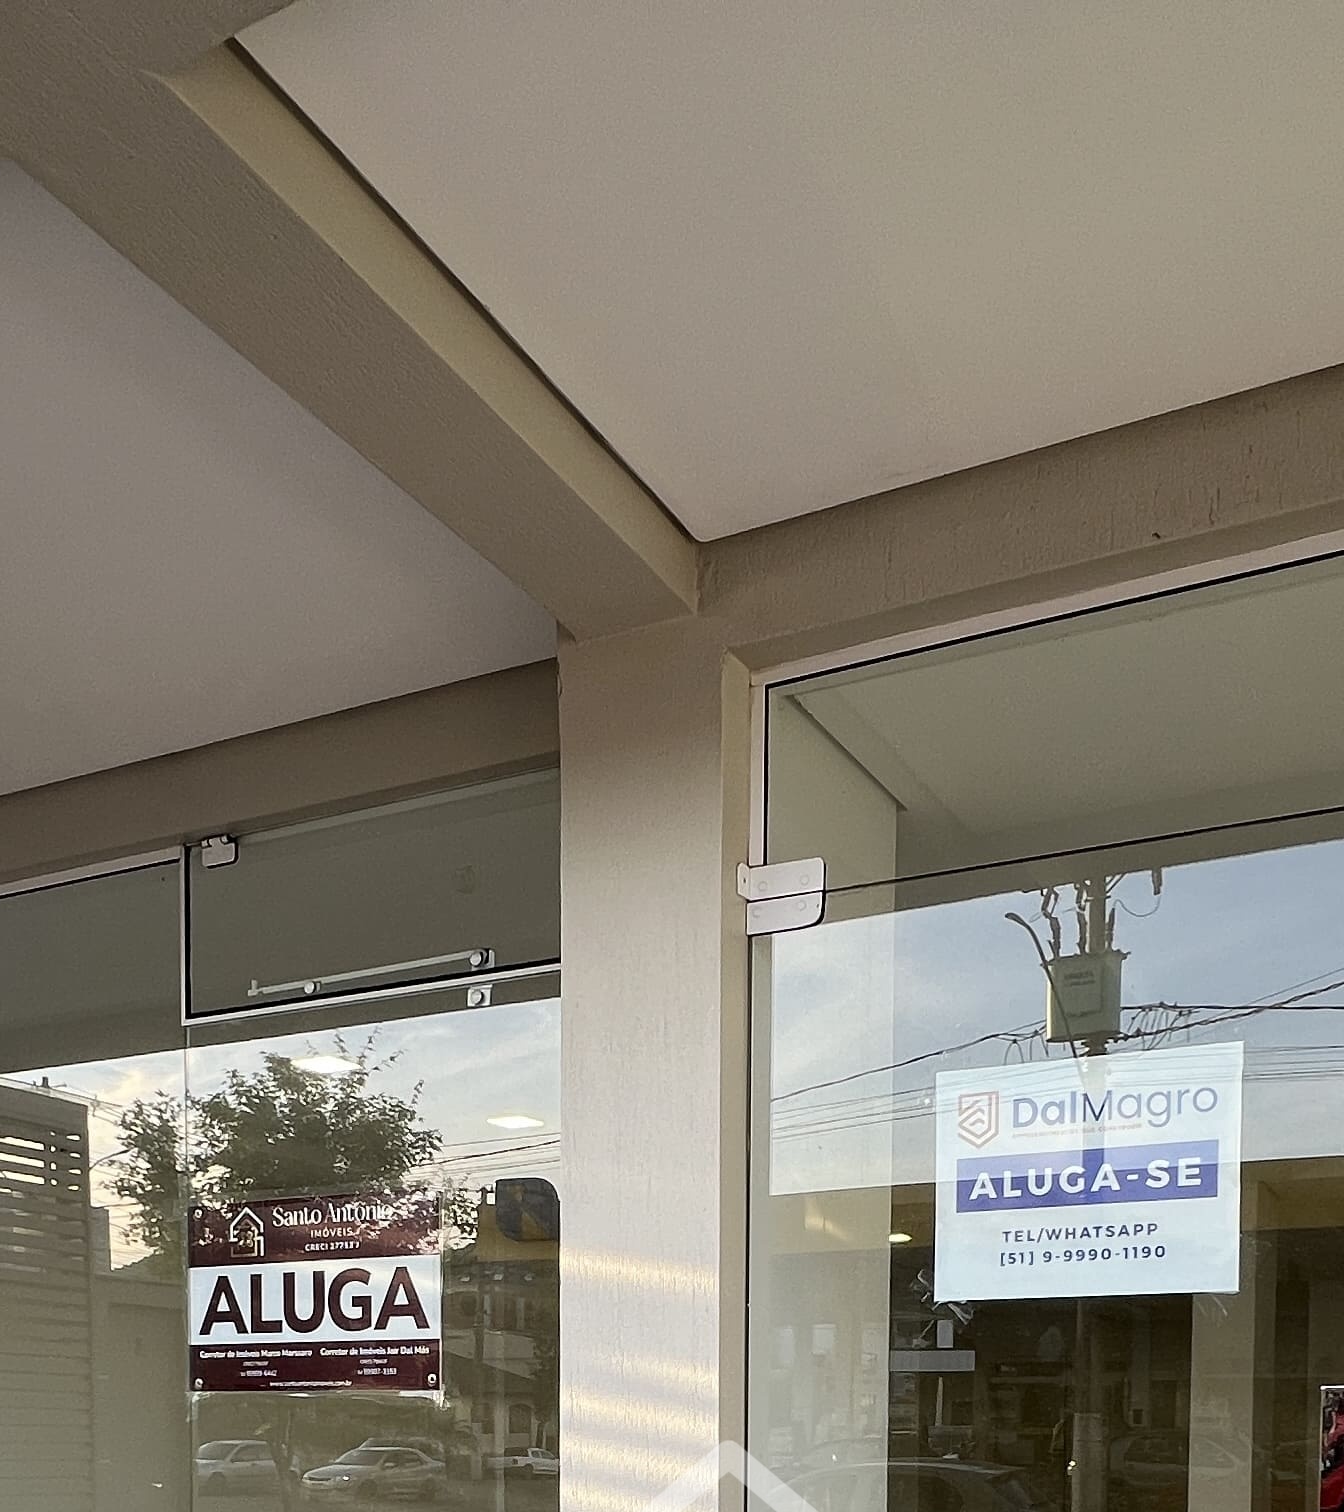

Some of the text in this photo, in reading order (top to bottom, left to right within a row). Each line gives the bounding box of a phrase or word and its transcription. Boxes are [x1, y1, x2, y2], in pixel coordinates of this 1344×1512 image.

[1012, 1086, 1218, 1128] DalMagro
[969, 1156, 1203, 1201] ALUGA-SE
[271, 1200, 393, 1228] Santo Antônio
[310, 1227, 353, 1239] IMÓVEIS
[1002, 1223, 1158, 1243] TEL/WHATSAPP
[304, 1242, 329, 1251] CRECI
[999, 1245, 1166, 1266] [51] 9-9990-1190
[199, 1266, 430, 1335] ALUGA
